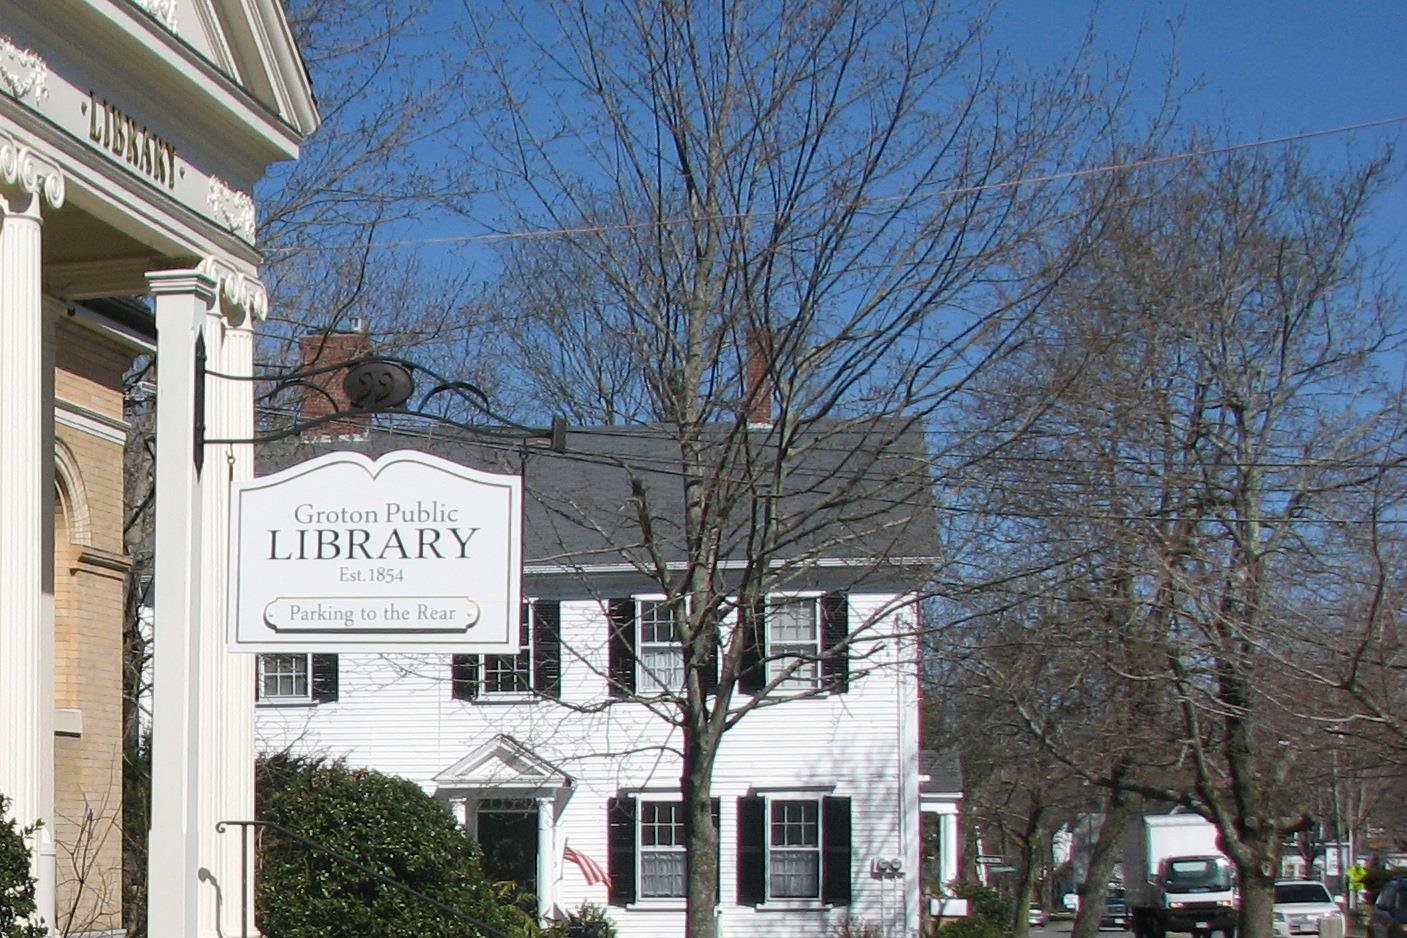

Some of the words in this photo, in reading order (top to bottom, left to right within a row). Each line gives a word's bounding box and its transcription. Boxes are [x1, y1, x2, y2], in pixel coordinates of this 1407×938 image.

[89, 90, 175, 190] LIBRARY
[294, 503, 378, 524] Groton
[385, 500, 459, 523] Public
[266, 527, 481, 560] LIBRARY
[369, 566, 404, 584] 1854
[290, 603, 354, 627] Parking
[361, 607, 377, 620] to
[384, 602, 410, 620] the
[418, 603, 457, 620] Rear
